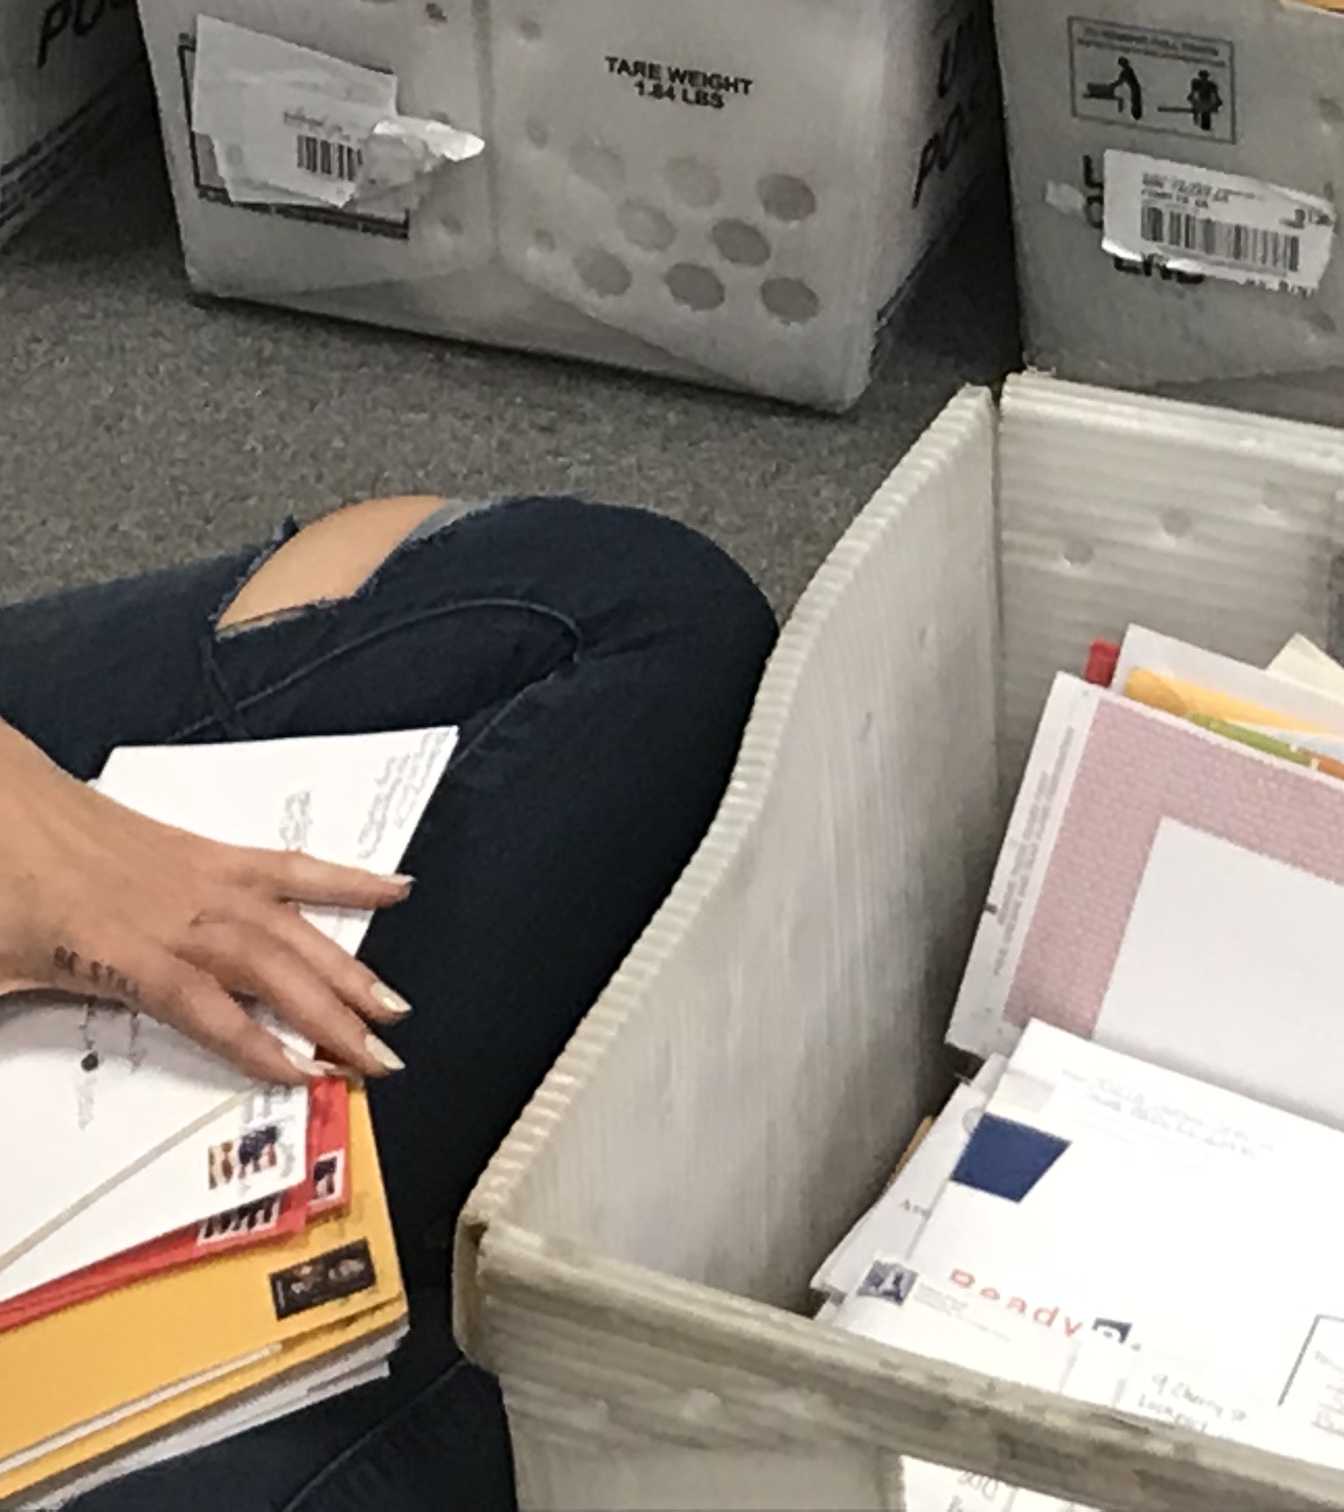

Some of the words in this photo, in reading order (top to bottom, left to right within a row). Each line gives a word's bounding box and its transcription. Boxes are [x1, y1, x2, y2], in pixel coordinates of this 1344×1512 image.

[605, 55, 662, 82] TARE
[666, 65, 754, 96] WEIGHT
[681, 87, 725, 110] LBS
